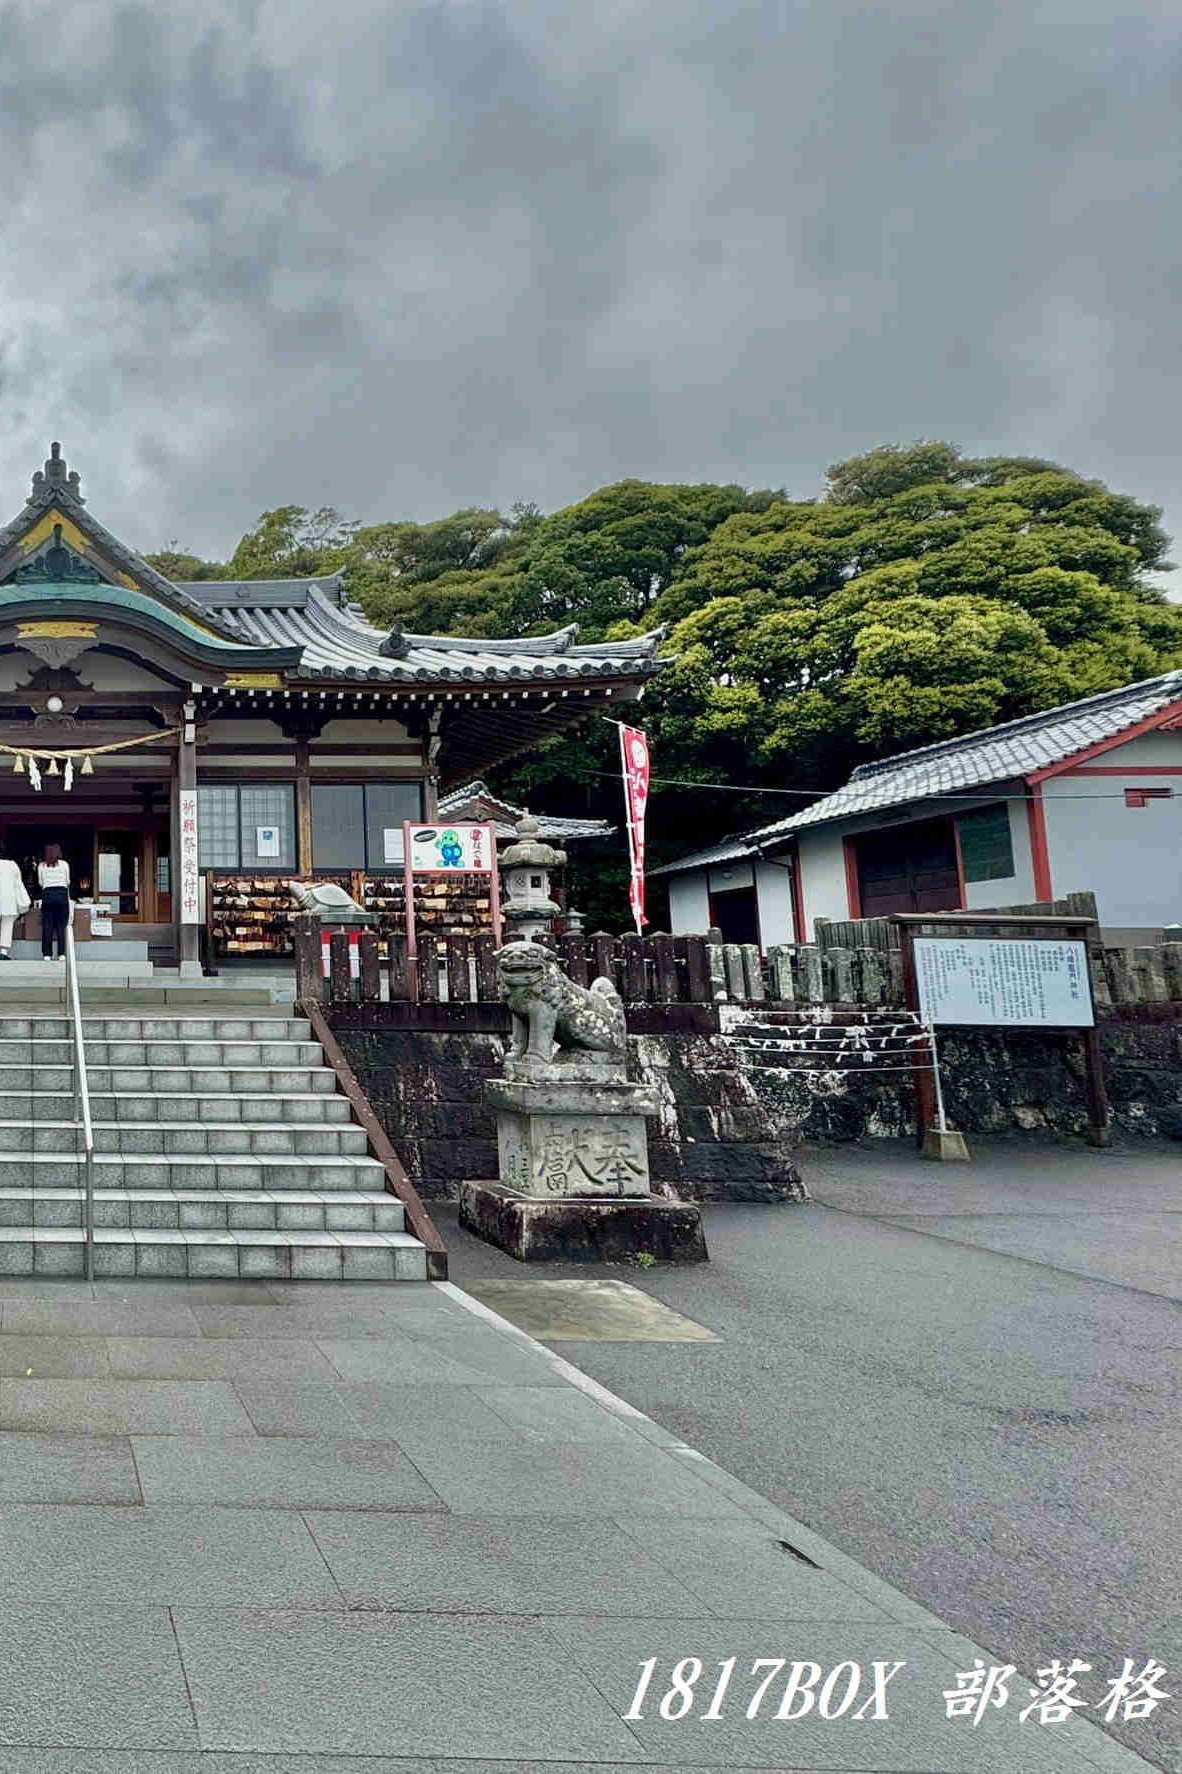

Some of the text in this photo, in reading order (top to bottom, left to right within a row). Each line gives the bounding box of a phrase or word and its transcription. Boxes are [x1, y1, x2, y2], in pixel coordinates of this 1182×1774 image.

[182, 799, 197, 912] 祈願祭受付中
